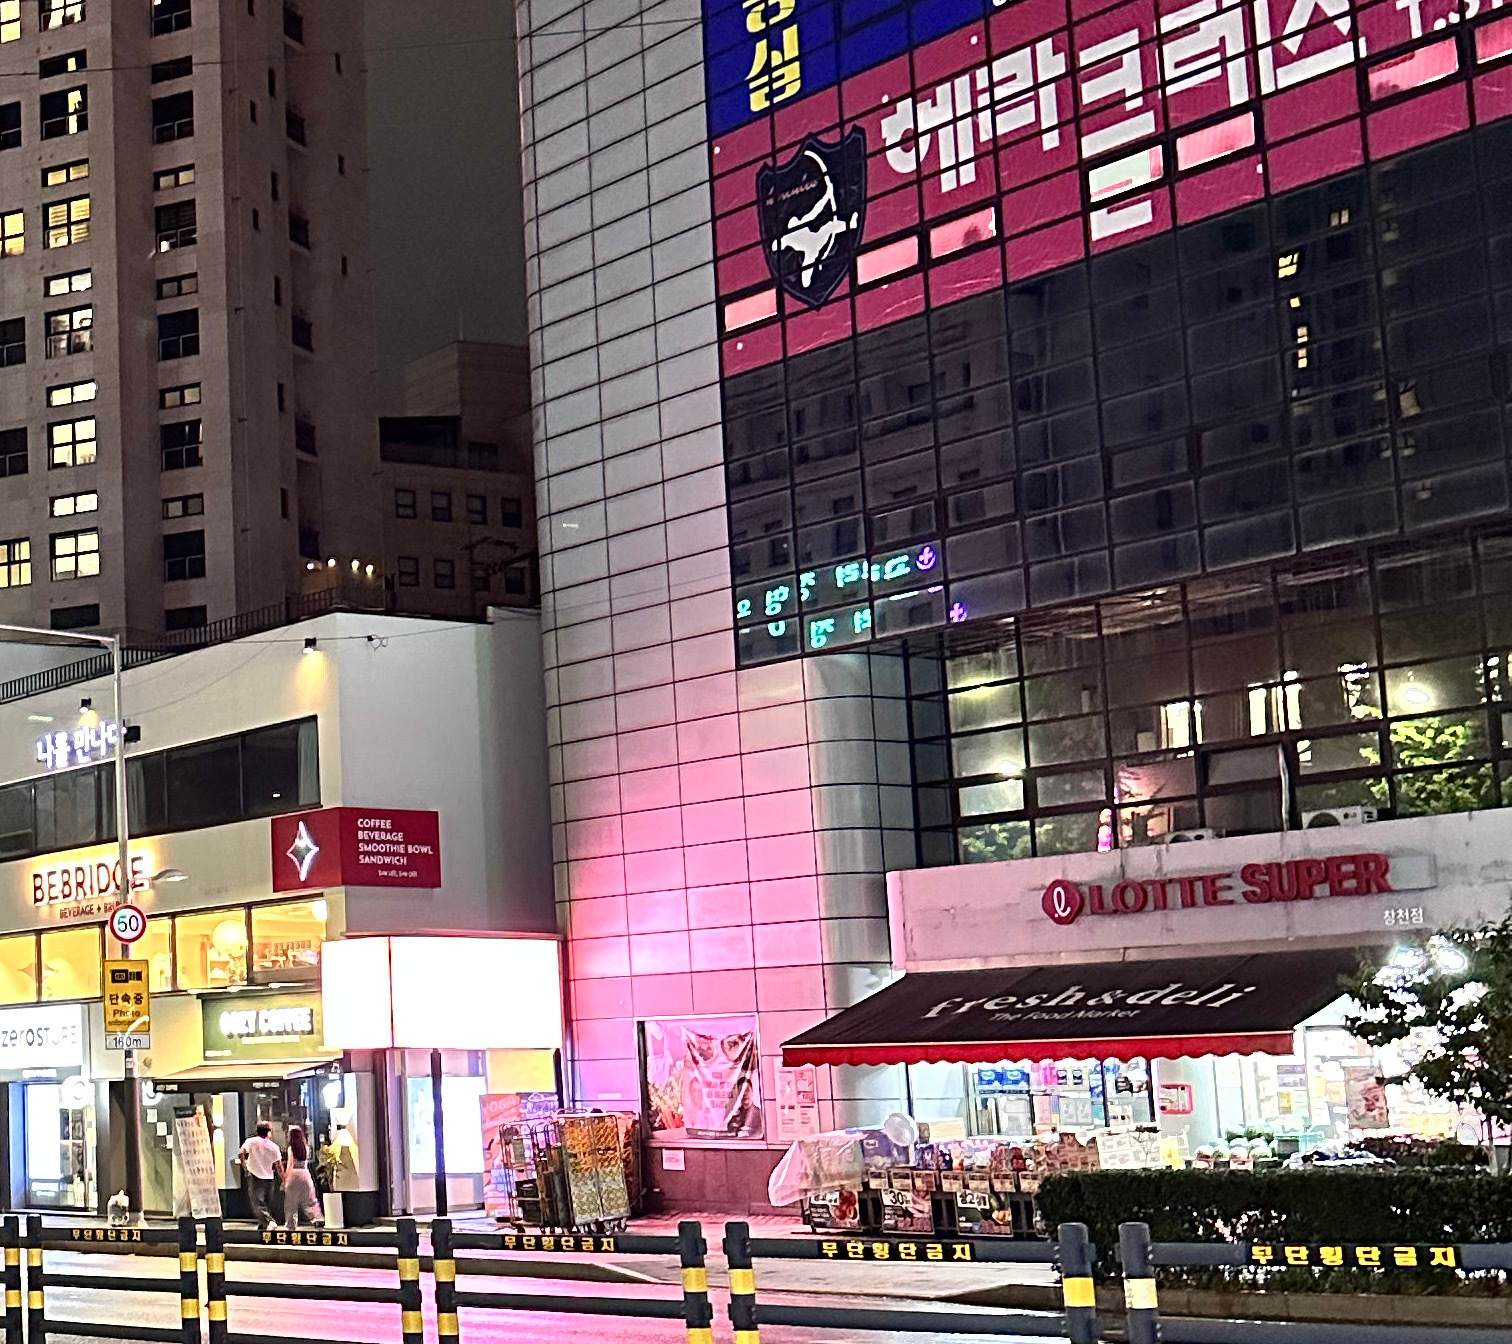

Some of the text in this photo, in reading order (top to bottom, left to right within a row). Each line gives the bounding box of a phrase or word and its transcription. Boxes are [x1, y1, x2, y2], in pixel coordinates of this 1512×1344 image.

[357, 818, 393, 830] COFFEE
[357, 830, 404, 842] BEVERAGE
[358, 842, 434, 855] SMOOTHIE BOWL
[358, 854, 408, 866] SANDWICH
[1088, 852, 1393, 916] LOTTE SUPER
[59, 904, 95, 920] BEVERAGE
[1383, 907, 1424, 926] 창천점
[117, 914, 139, 933] 50
[920, 982, 1257, 1019] fresh&deli
[504, 1234, 616, 1252] 무단횡단금지
[821, 1240, 972, 1261] 무단횡단금지
[1251, 1244, 1457, 1268] 무단횡단금지
